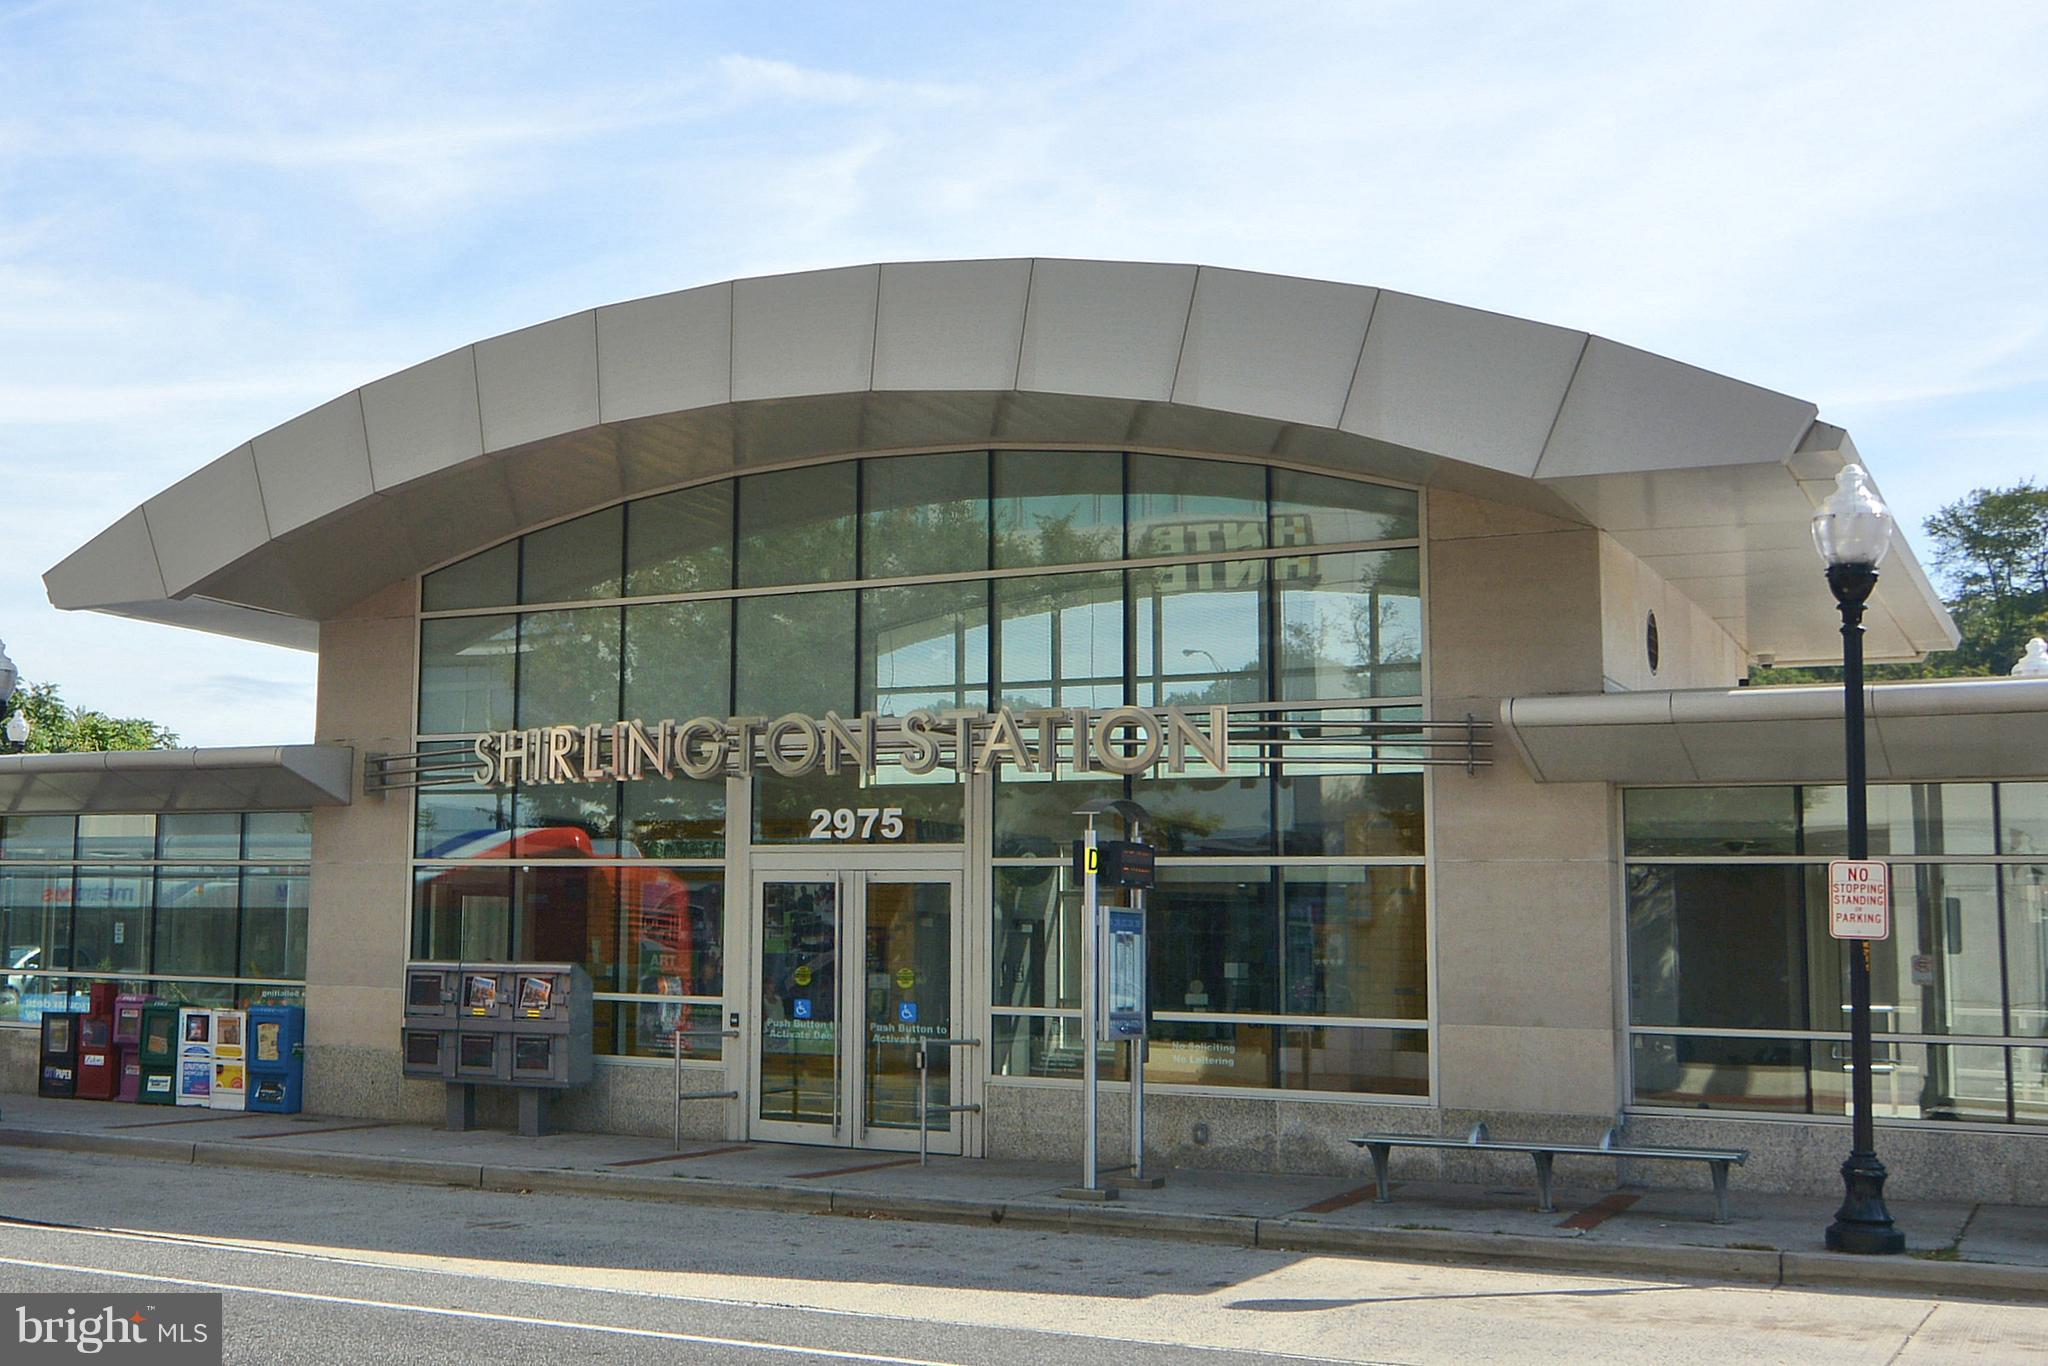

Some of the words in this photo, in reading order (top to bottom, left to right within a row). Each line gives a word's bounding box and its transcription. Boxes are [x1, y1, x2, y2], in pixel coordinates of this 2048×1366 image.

[473, 709, 877, 789] SHIRLINGTON
[900, 704, 1229, 776] STATION
[810, 808, 904, 839] 2975
[1089, 849, 1098, 870] D
[1848, 868, 1868, 881] NO
[1833, 883, 1884, 894] STOPPING
[1833, 895, 1884, 906] STANDING
[1836, 912, 1882, 924] PARKING
[767, 1018, 790, 1028] Push
[794, 1019, 826, 1029] Button
[870, 1023, 895, 1033] Push
[898, 1024, 933, 1034] Button
[936, 1026, 947, 1035] to
[770, 1029, 810, 1039] Activate
[813, 1031, 834, 1041] Doo
[1172, 1041, 1186, 1050] No
[1188, 1041, 1235, 1054] Soliciting
